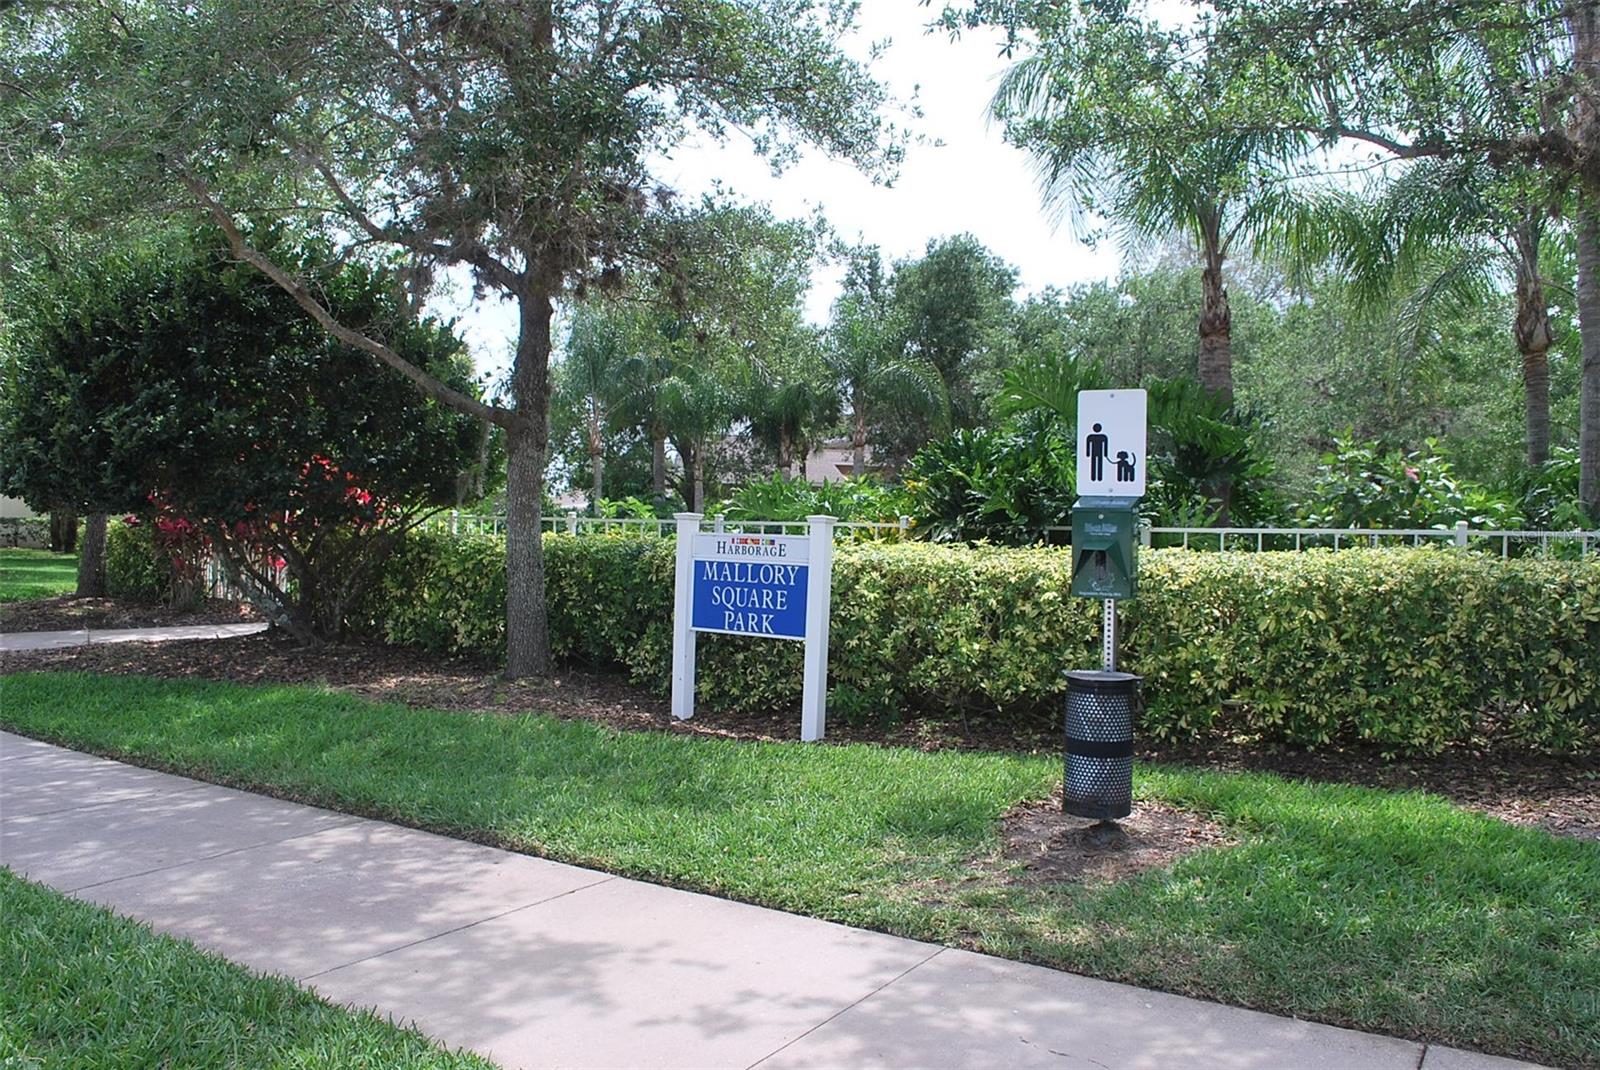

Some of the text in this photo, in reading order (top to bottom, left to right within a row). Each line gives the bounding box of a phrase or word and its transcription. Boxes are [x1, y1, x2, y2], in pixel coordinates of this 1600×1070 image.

[717, 541, 787, 558] HARBORAGE
[703, 562, 799, 586] MALLORY
[712, 586, 788, 611] SQUARE
[724, 611, 775, 634] PARK
